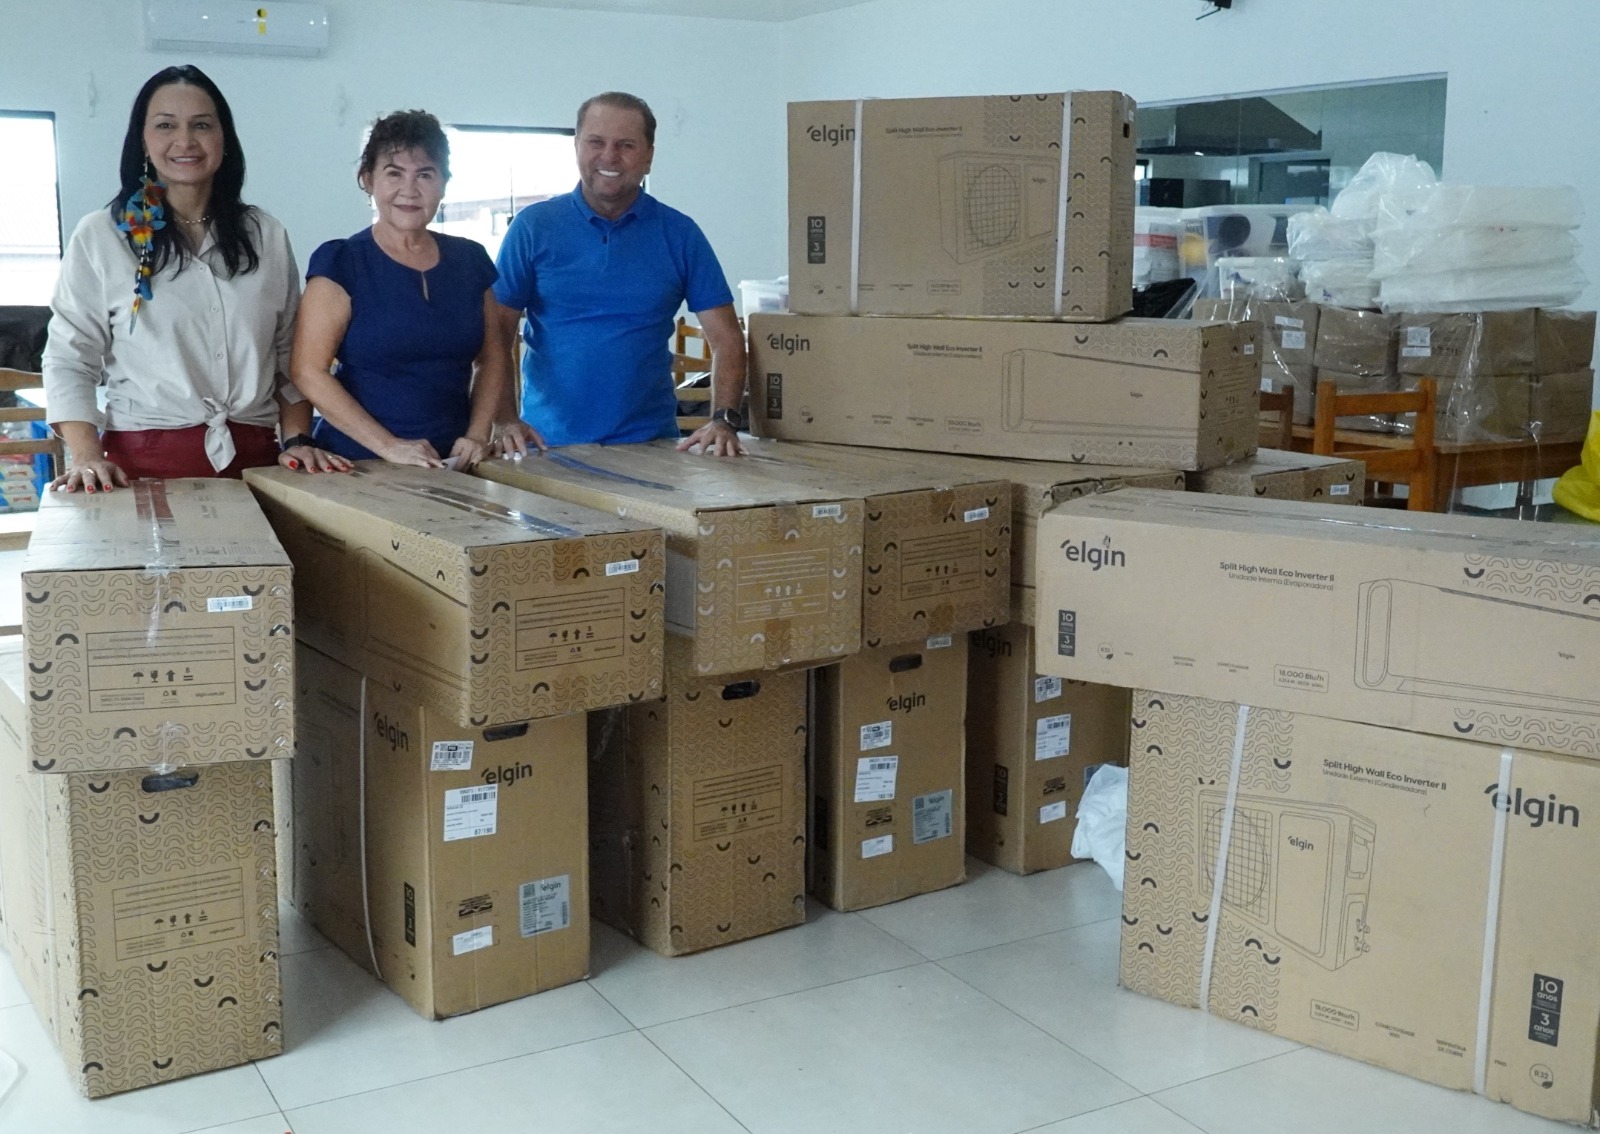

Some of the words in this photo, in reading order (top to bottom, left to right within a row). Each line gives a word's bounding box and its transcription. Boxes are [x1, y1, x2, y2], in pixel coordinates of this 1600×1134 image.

[811, 219, 822, 228] 10
[814, 242, 820, 251] 3
[767, 333, 810, 356] elgin
[769, 376, 780, 385] 10
[1060, 537, 1126, 571] elgin
[1220, 562, 1237, 571] Split
[1239, 564, 1257, 574] High
[1259, 566, 1277, 575] Wall
[1279, 568, 1293, 577] Eco
[1295, 570, 1328, 581] Inverter
[1229, 573, 1257, 582] Unidade
[1259, 576, 1282, 585] Interna
[1284, 579, 1334, 591] (Evaporadora)
[1062, 612, 1073, 622] 10
[972, 631, 1011, 657] elgin
[1064, 635, 1070, 644] 3
[886, 693, 926, 713] elgin
[374, 712, 409, 752] elgin
[481, 761, 533, 787] elgin
[1323, 759, 1342, 769] Split
[1344, 763, 1363, 774] High
[1365, 767, 1385, 778] Wall
[1387, 771, 1402, 782] Eco
[1404, 774, 1440, 789] Inverter
[1323, 769, 1349, 779] Unidade
[1375, 779, 1428, 796] (Condensadora)
[1287, 835, 1314, 851] elgin
[541, 882, 561, 891] elgin
[1539, 978, 1558, 994] 10
[1536, 991, 1558, 1002] anos
[1540, 1012, 1550, 1026] 3
[1533, 1023, 1555, 1036] anos
